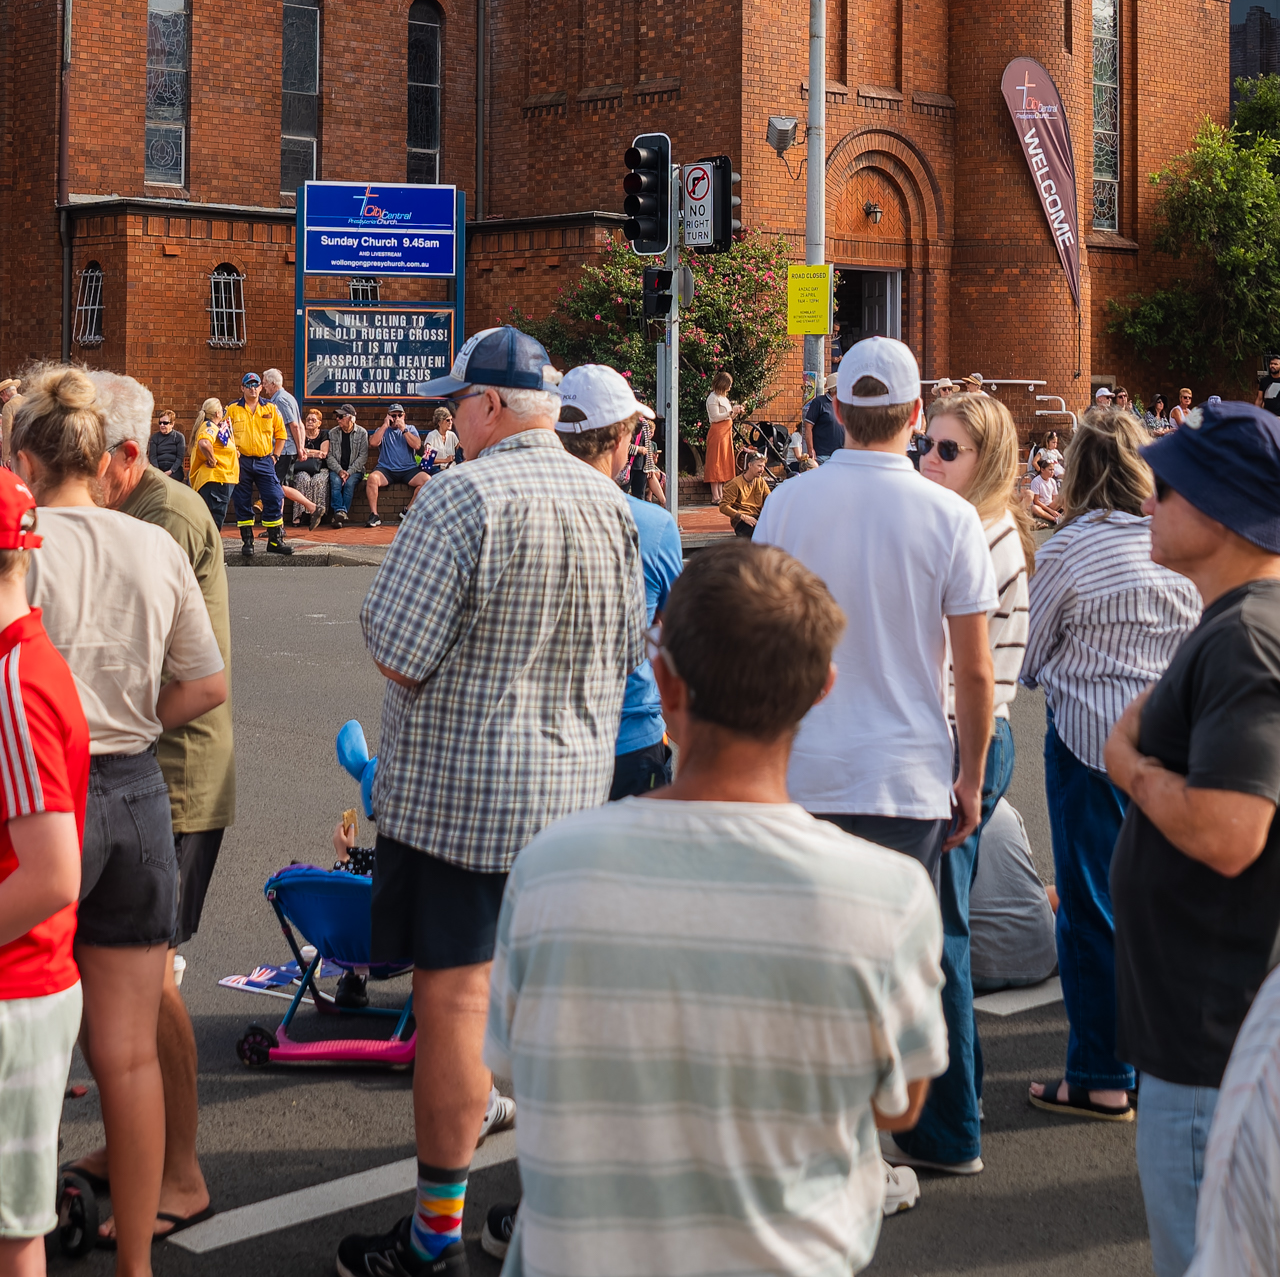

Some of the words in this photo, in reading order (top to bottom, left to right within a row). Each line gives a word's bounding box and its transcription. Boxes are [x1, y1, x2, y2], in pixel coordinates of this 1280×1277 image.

[1023, 127, 1075, 250] WELCOME
[690, 204, 706, 217] NO
[686, 219, 709, 229] RIGHT
[320, 235, 359, 248] Sunday
[361, 236, 398, 247] Church
[403, 238, 440, 248] 9.45am
[686, 231, 709, 240] TURN
[331, 259, 430, 268] wollongongpresychurch.com.au
[335, 314, 339, 326] I
[344, 314, 368, 327] WILL
[374, 315, 406, 327] CLING
[412, 315, 425, 327] TO
[309, 327, 330, 339] THE
[335, 327, 357, 340] OLD
[361, 327, 404, 340] RUGGED
[409, 328, 448, 341] CROSS!
[352, 341, 363, 353] IT
[368, 342, 379, 353] IS
[384, 342, 398, 354] MY
[316, 354, 373, 367] PASSPORT
[380, 355, 393, 367] TO
[399, 355, 446, 368] HEAVEN!
[328, 368, 363, 380] THANK
[370, 369, 390, 381] YOU
[396, 369, 431, 381] JESUS
[335, 382, 356, 394] FOR
[362, 382, 401, 394] SAVING
